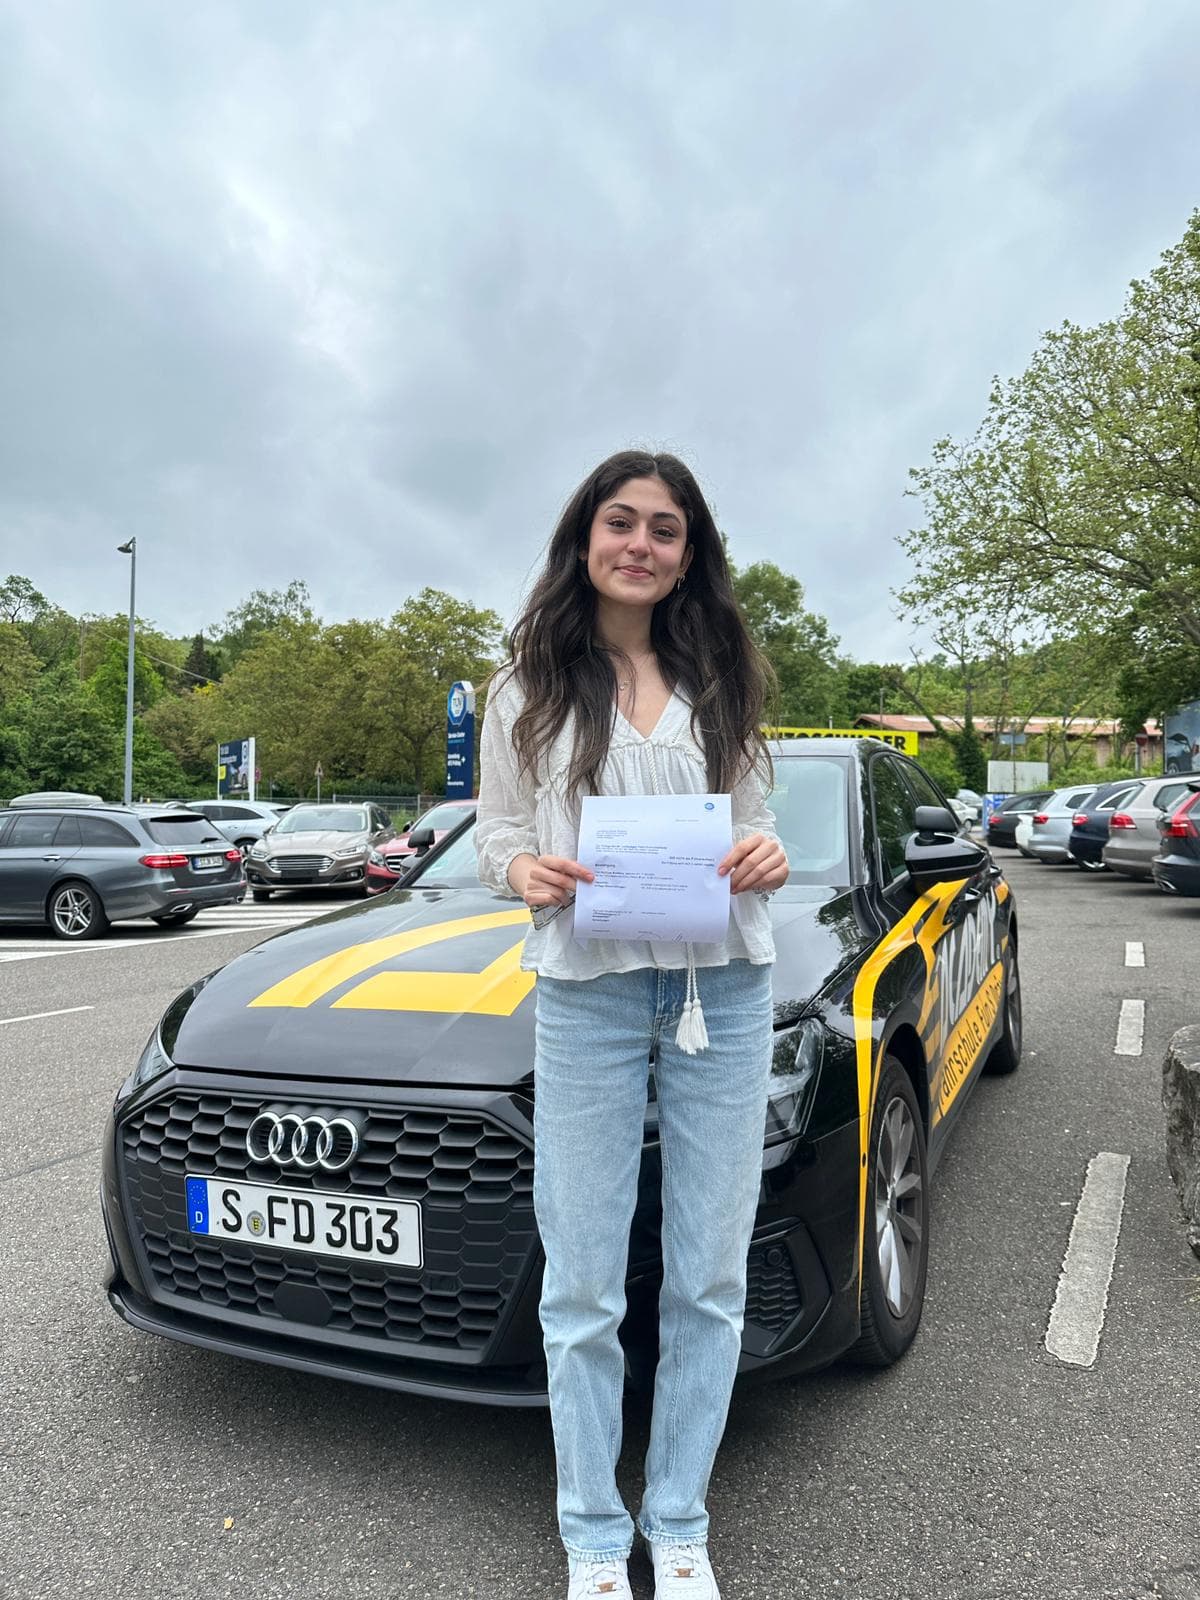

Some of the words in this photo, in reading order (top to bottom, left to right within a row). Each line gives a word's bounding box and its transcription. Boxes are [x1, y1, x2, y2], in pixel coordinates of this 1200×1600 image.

[195, 1210, 204, 1224] D
[222, 1188, 243, 1233] S
[267, 1195, 315, 1244] FD
[326, 1202, 400, 1255] 303
